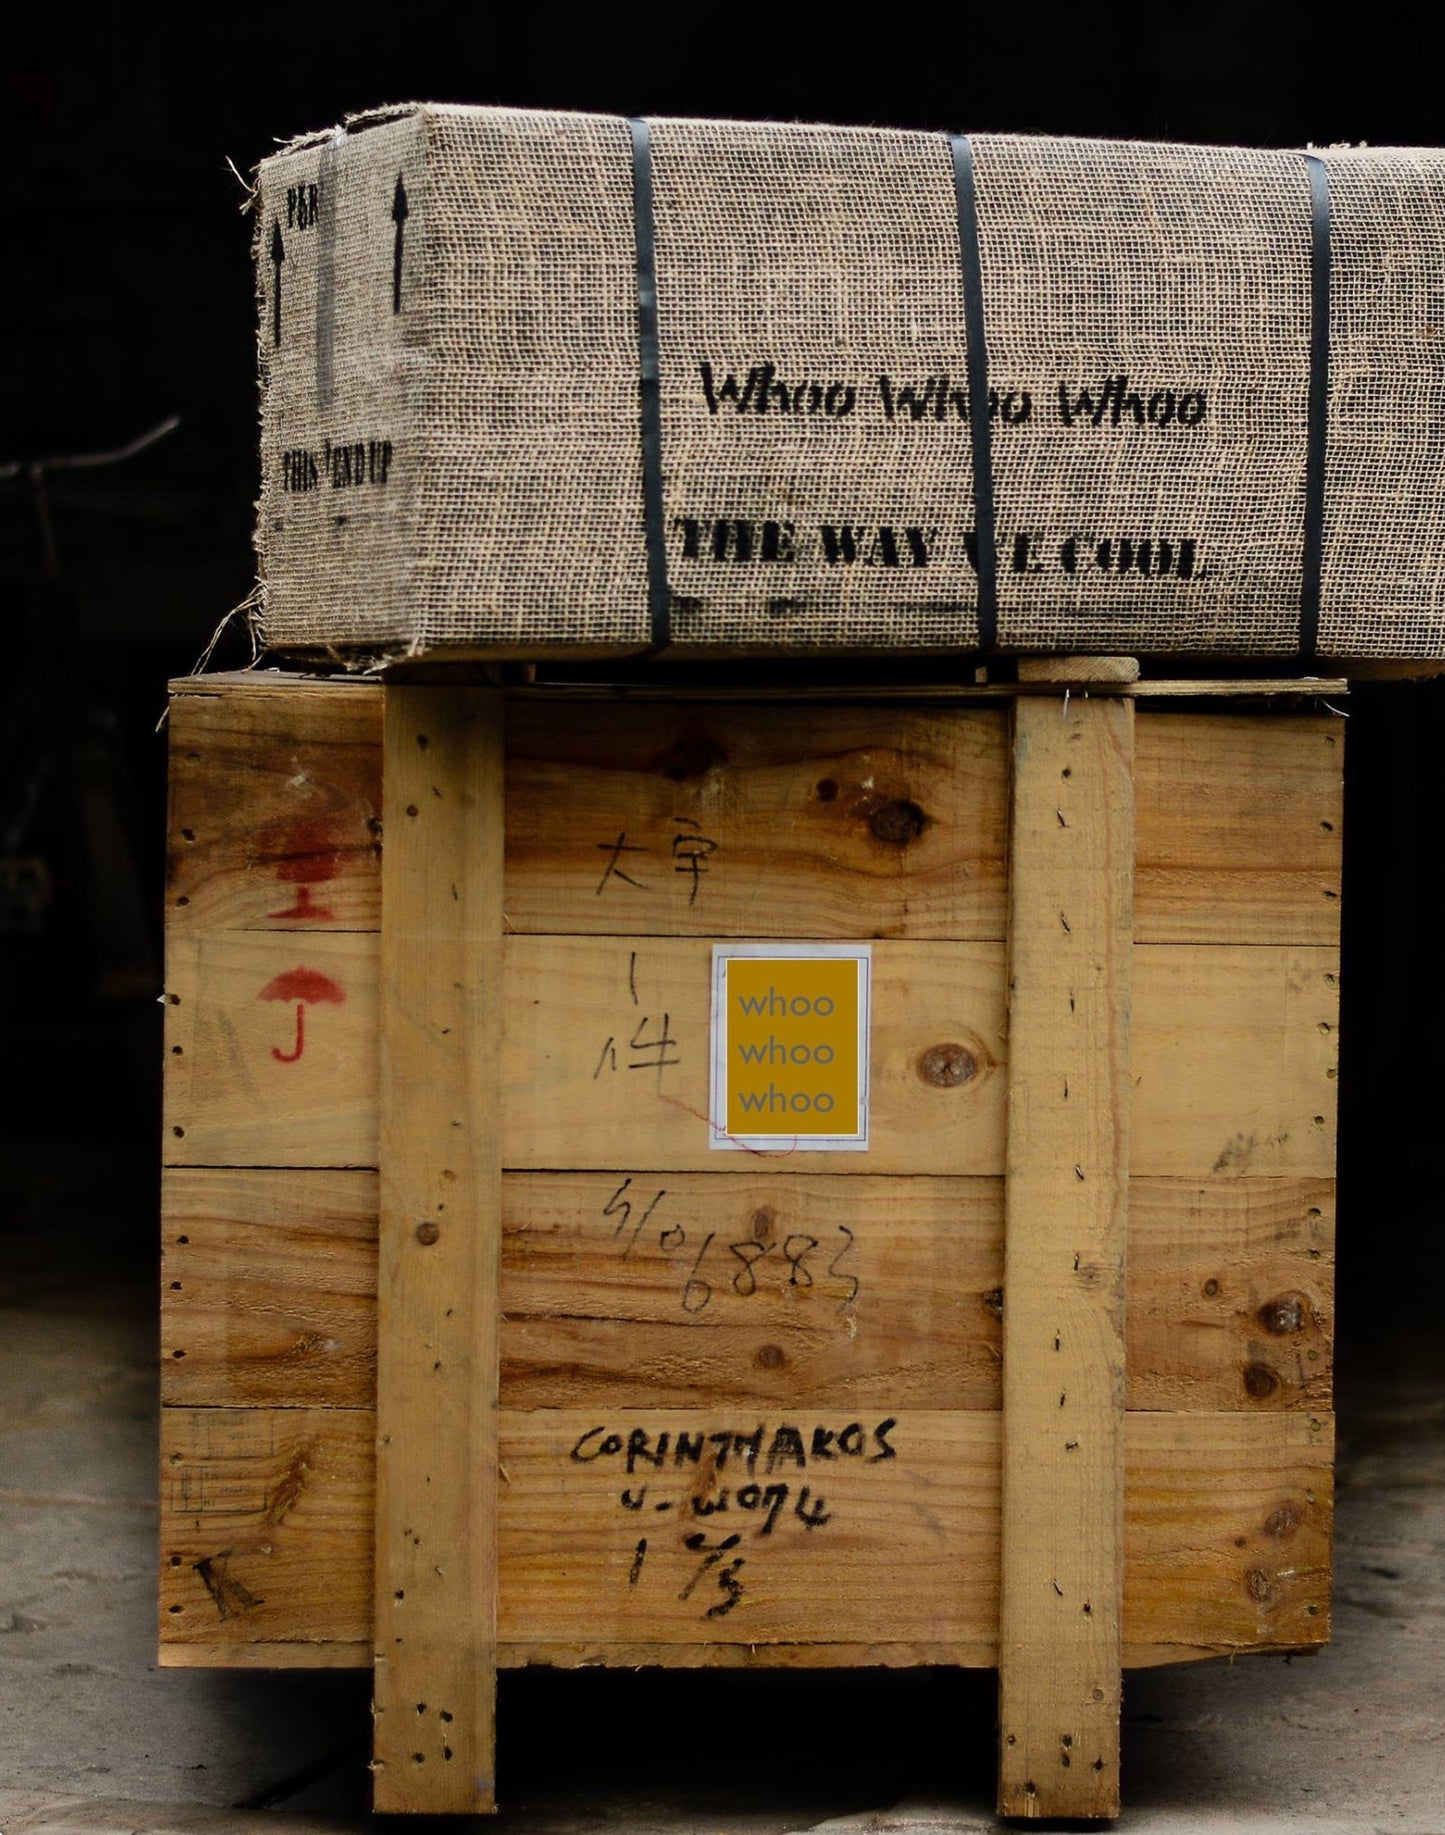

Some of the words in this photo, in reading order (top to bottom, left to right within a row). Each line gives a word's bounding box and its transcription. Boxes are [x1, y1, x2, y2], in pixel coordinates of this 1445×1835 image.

[699, 361, 854, 416] Whoo
[1058, 374, 1208, 427] Whoo
[370, 440, 393, 484] UP
[673, 518, 796, 562] THE
[819, 524, 941, 567] WAY
[738, 986, 835, 1017] whoo
[738, 1035, 835, 1066] whoo
[738, 1083, 835, 1114] whoo
